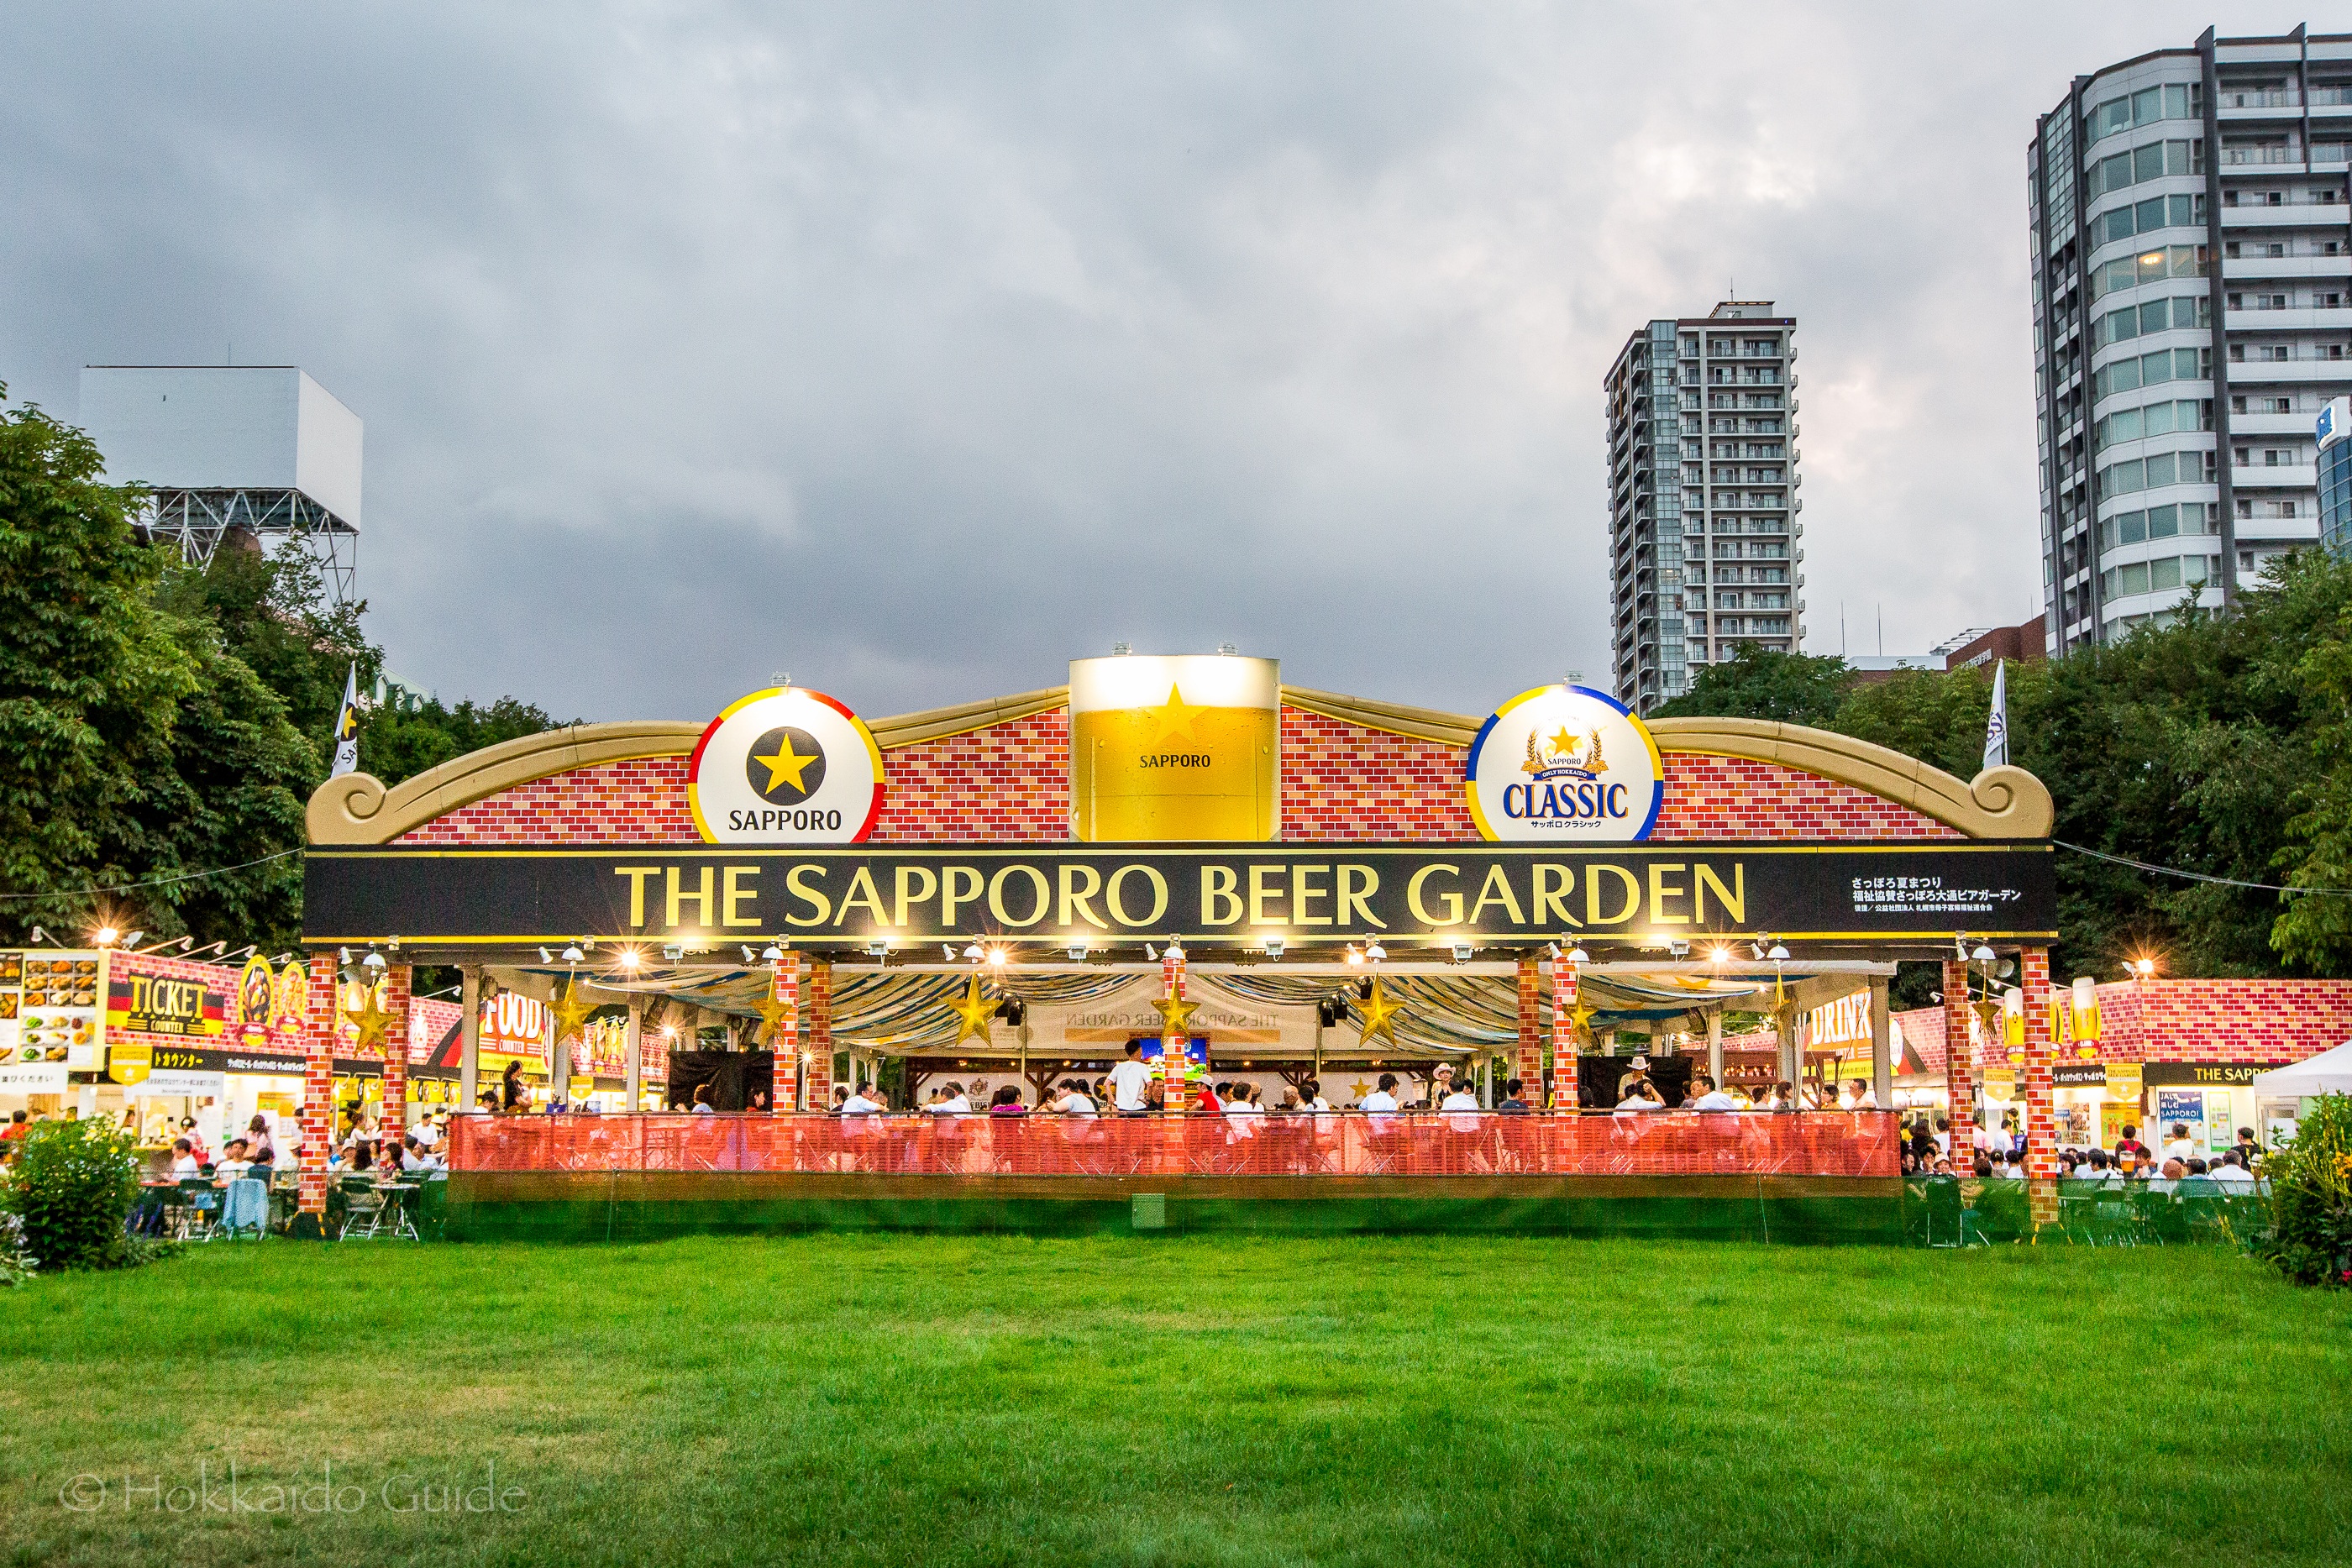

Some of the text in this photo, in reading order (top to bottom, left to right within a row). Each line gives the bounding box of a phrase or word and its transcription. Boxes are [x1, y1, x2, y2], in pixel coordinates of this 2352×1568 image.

[1139, 754, 1210, 768] SAPPORO
[1542, 768, 1588, 778] ONLY HOKKAIDO
[1503, 783, 1629, 819] CLASSIC
[728, 810, 842, 831] SAPPORO
[1851, 877, 1941, 889] さっぽろ夏まつり
[614, 863, 1745, 929] THE SAPPORO BEER GARDEN
[1852, 889, 2021, 902] 福祉協賛さっぽろ大通ビアガーデン
[129, 975, 208, 1019] TICKET
[485, 991, 542, 1039] FOOD
[1811, 991, 1873, 1045] DRINK
[150, 1020, 184, 1034] COUNTER
[498, 1039, 525, 1053] COUNTER
[155, 1051, 203, 1067] トカウンター
[2194, 1067, 2222, 1081] THE
